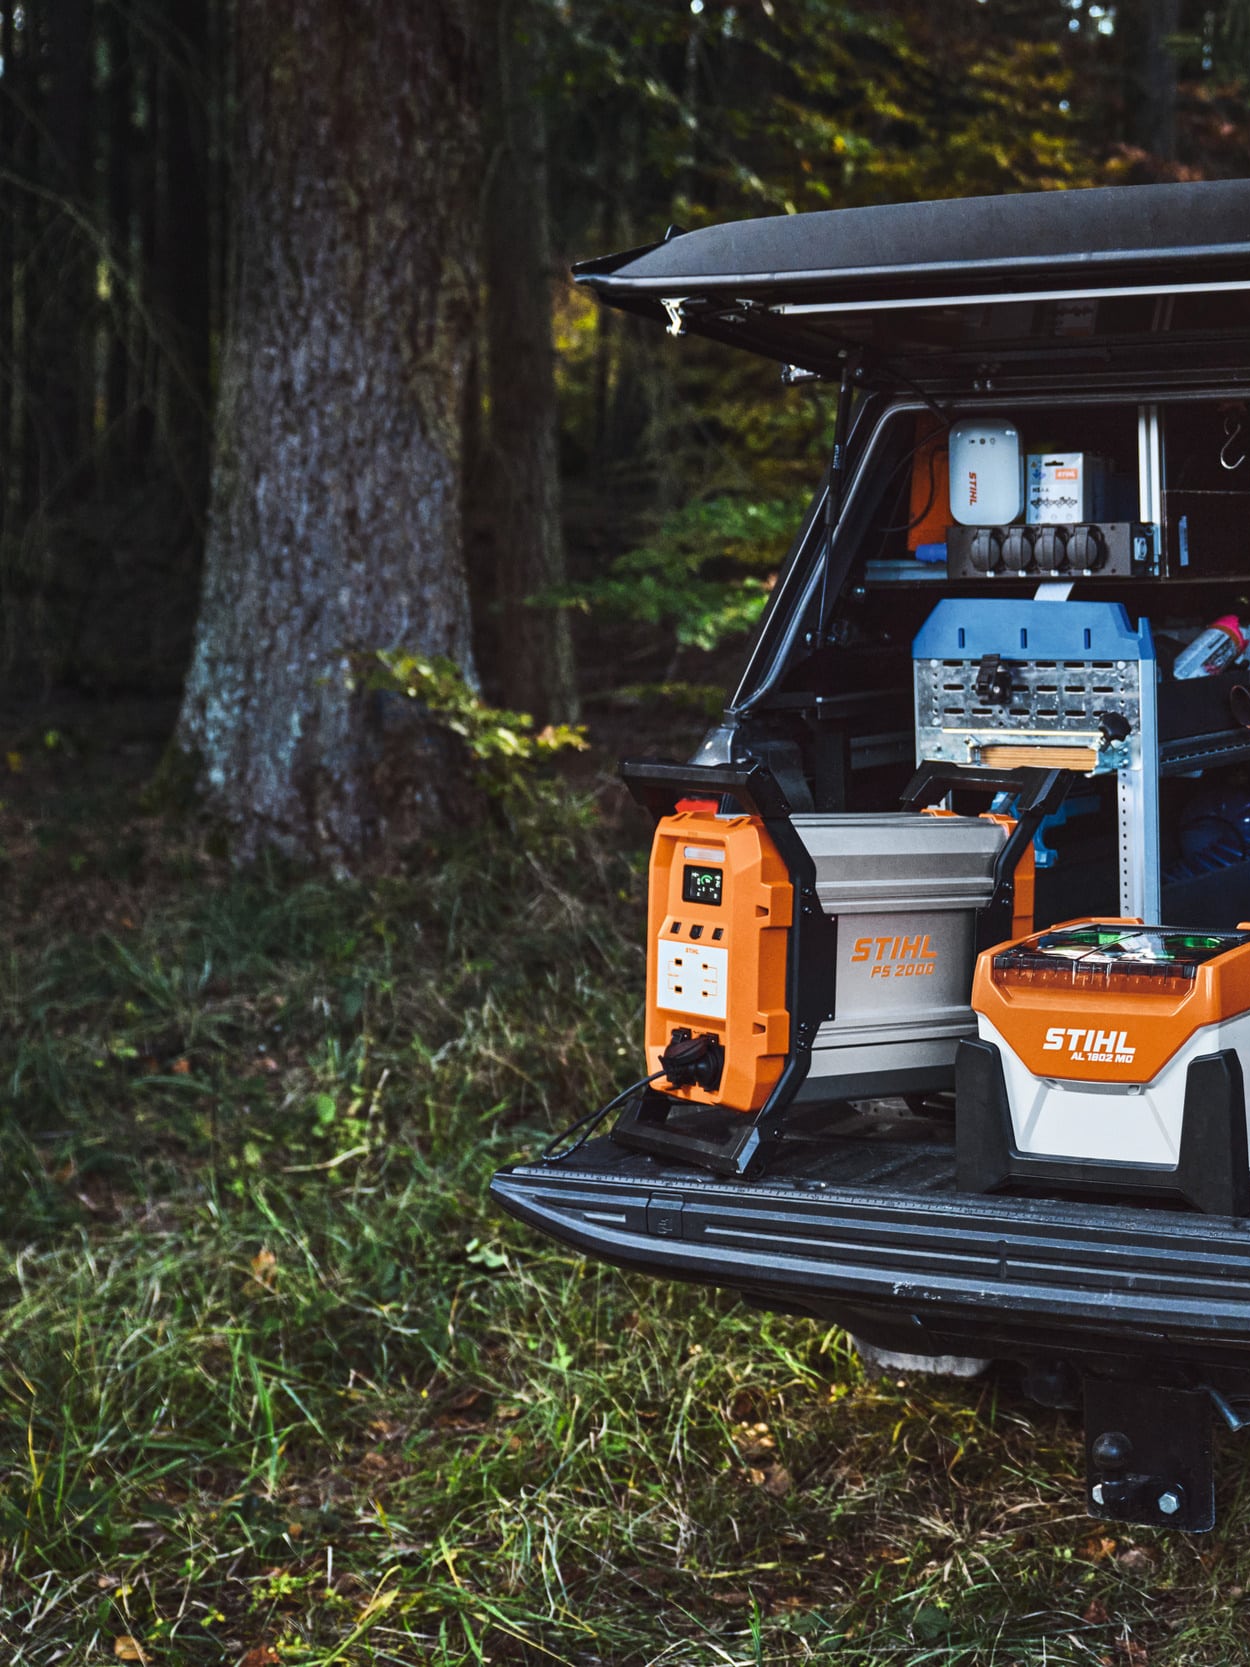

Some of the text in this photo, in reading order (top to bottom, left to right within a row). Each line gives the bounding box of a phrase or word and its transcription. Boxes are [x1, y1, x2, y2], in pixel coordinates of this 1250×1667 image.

[968, 471, 977, 506] STIHL
[850, 934, 938, 962] STIHL
[871, 962, 935, 978] PS 2000
[1042, 1027, 1136, 1054] STIHL
[1070, 1052, 1085, 1061] AL
[1087, 1053, 1113, 1062] 1802
